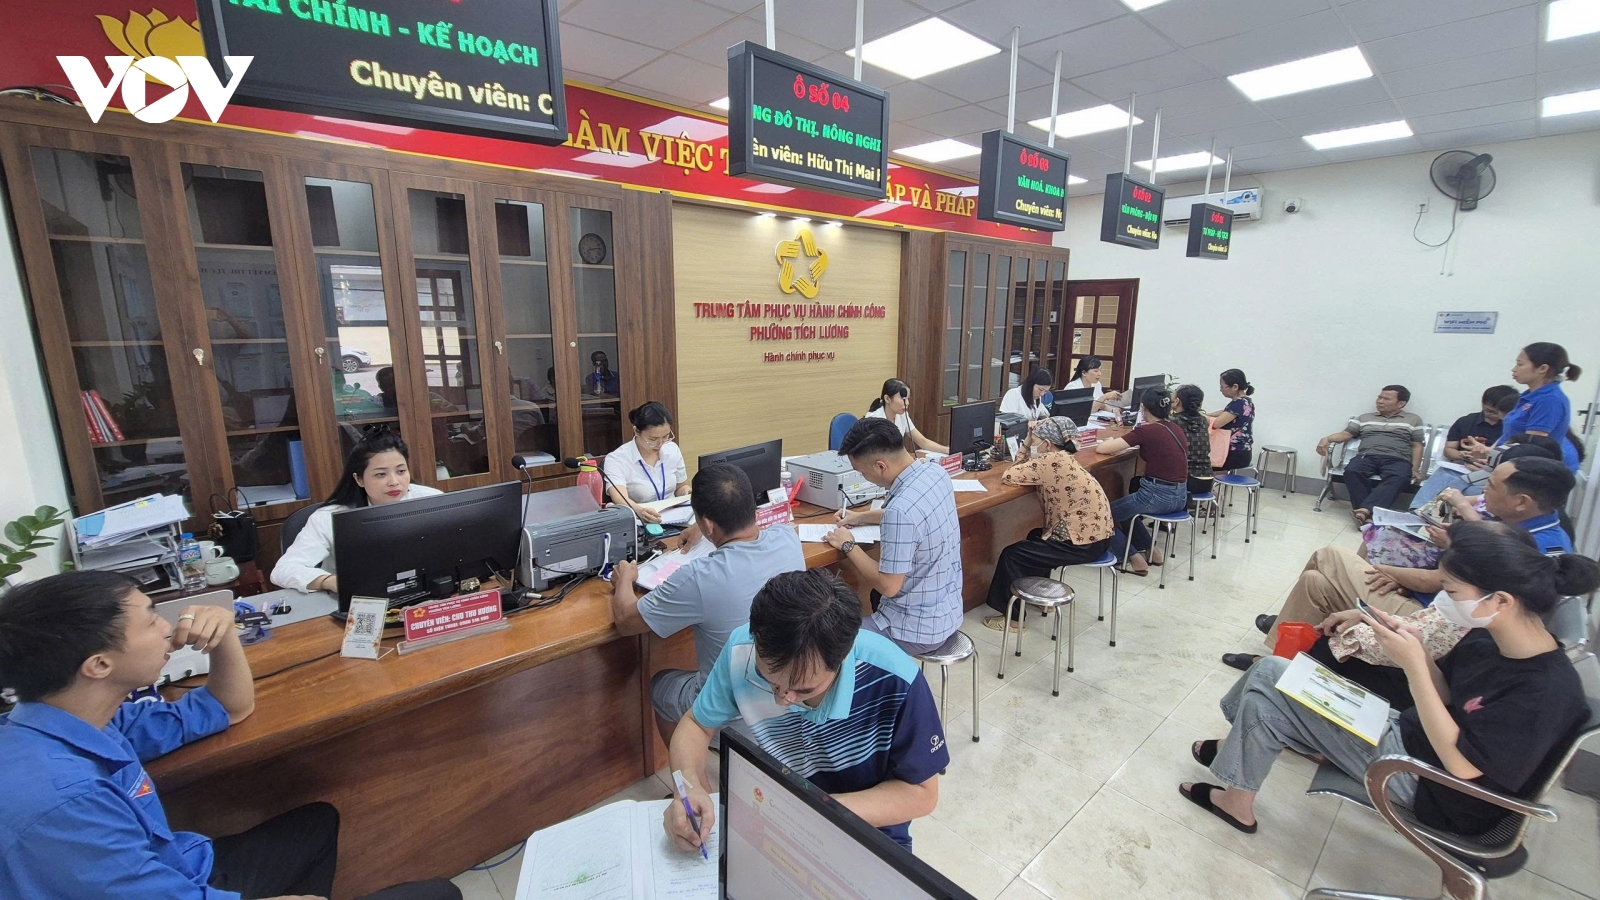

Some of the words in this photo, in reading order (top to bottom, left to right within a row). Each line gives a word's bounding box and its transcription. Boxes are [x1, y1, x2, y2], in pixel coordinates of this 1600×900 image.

[288, 0, 391, 37] CHÍNH
[417, 21, 453, 49] KẾ
[457, 30, 539, 67] HOẠCH
[350, 59, 462, 100] Chuyên
[467, 82, 530, 112] viên:
[793, 74, 806, 98] Ô
[809, 83, 829, 106] SỐ
[832, 92, 849, 112] 04
[774, 110, 793, 128] ĐÔ
[822, 123, 854, 145] NÔNG
[562, 108, 630, 157] ÀM
[639, 131, 713, 175] VIỆC
[909, 183, 932, 210] VÀ
[935, 191, 975, 217] PHÁP
[771, 145, 803, 165] viên:
[807, 152, 832, 172] Hữu
[835, 159, 853, 180] Thị
[855, 163, 874, 181] Mai
[1017, 175, 1030, 189] VĂN
[1016, 199, 1039, 215] Chuyên
[693, 303, 735, 318] TRUNG
[736, 300, 760, 318] TÂM
[764, 303, 791, 321] PHỤC
[793, 303, 806, 321] VỤ
[809, 302, 834, 318] HÀNH
[837, 302, 862, 318] CHÍNH
[864, 303, 885, 318] CÔNG
[750, 322, 792, 340] PHƯỜNG
[794, 323, 815, 339] TÍCH
[819, 324, 849, 339] LƯƠNG
[764, 351, 783, 362] Hành
[786, 351, 806, 362] chính
[808, 352, 825, 363] phục
[826, 353, 835, 361] vụ
[411, 618, 434, 631] CHUYÊN
